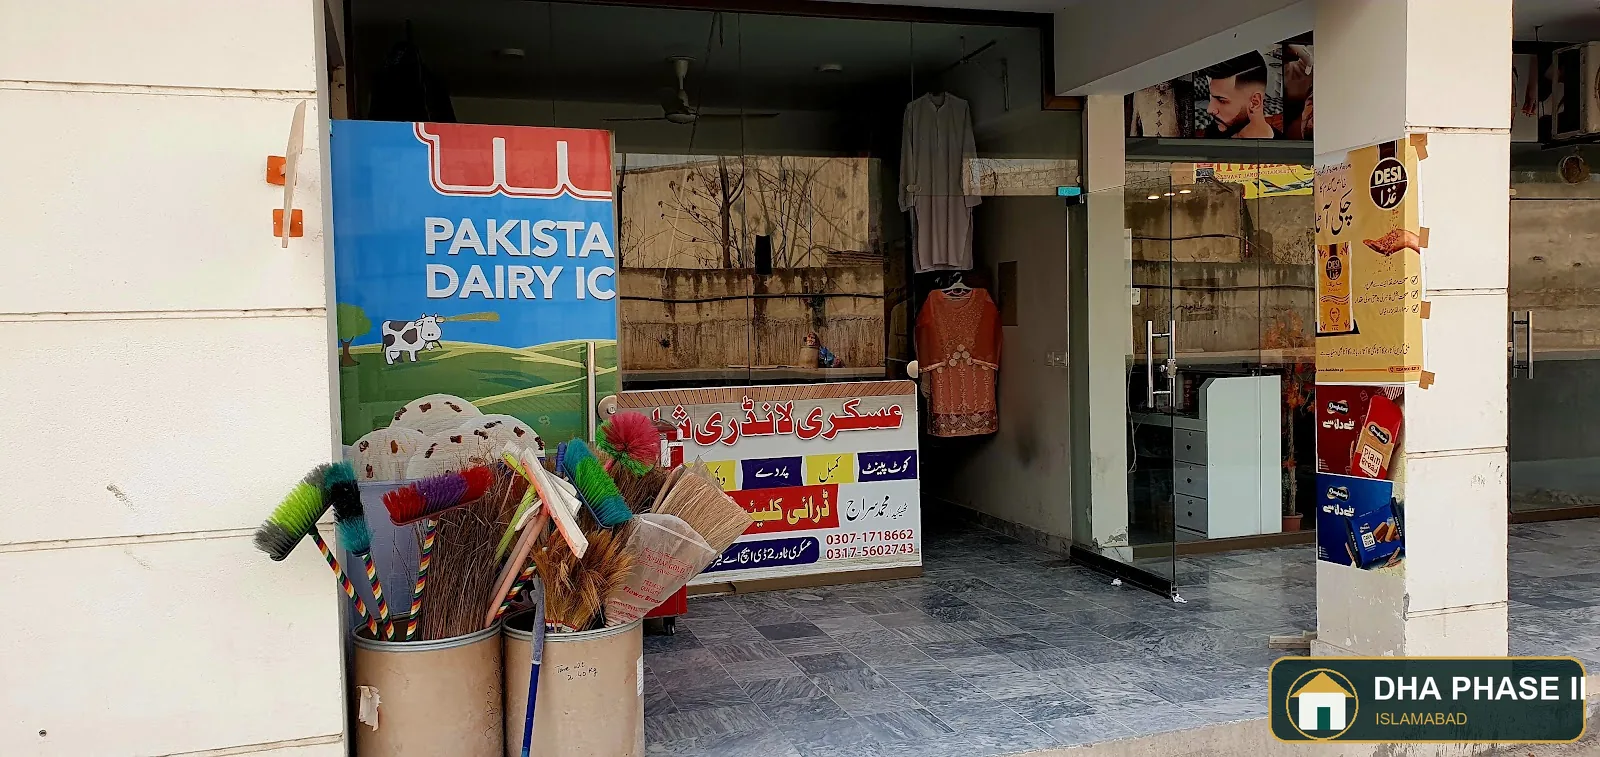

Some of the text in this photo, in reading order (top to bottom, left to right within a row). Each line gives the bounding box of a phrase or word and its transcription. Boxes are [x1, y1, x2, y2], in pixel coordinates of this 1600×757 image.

[1374, 166, 1402, 186] DESI
[1380, 184, 1397, 207] غذا
[424, 217, 615, 258] PAKISTA
[426, 263, 616, 300] DAIRY IC
[694, 395, 794, 446] لانڈری
[796, 398, 904, 440] عسکری
[888, 455, 912, 473] کوٹ
[1364, 448, 1381, 466] Plain
[755, 465, 789, 479] پردے
[819, 456, 842, 482] کمبل
[787, 488, 830, 525] ڈرائی
[846, 496, 879, 521] سراج
[874, 495, 890, 518] محمد
[826, 529, 914, 545] 0307-1718662
[723, 552, 740, 564] اے
[740, 547, 753, 564] ایچ
[754, 547, 767, 563] ڈی
[767, 548, 774, 559] 2
[774, 547, 788, 560] ٹاور
[788, 539, 812, 560] عسکری
[826, 543, 914, 559] 0317-5602743
[623, 586, 644, 599] Flower
